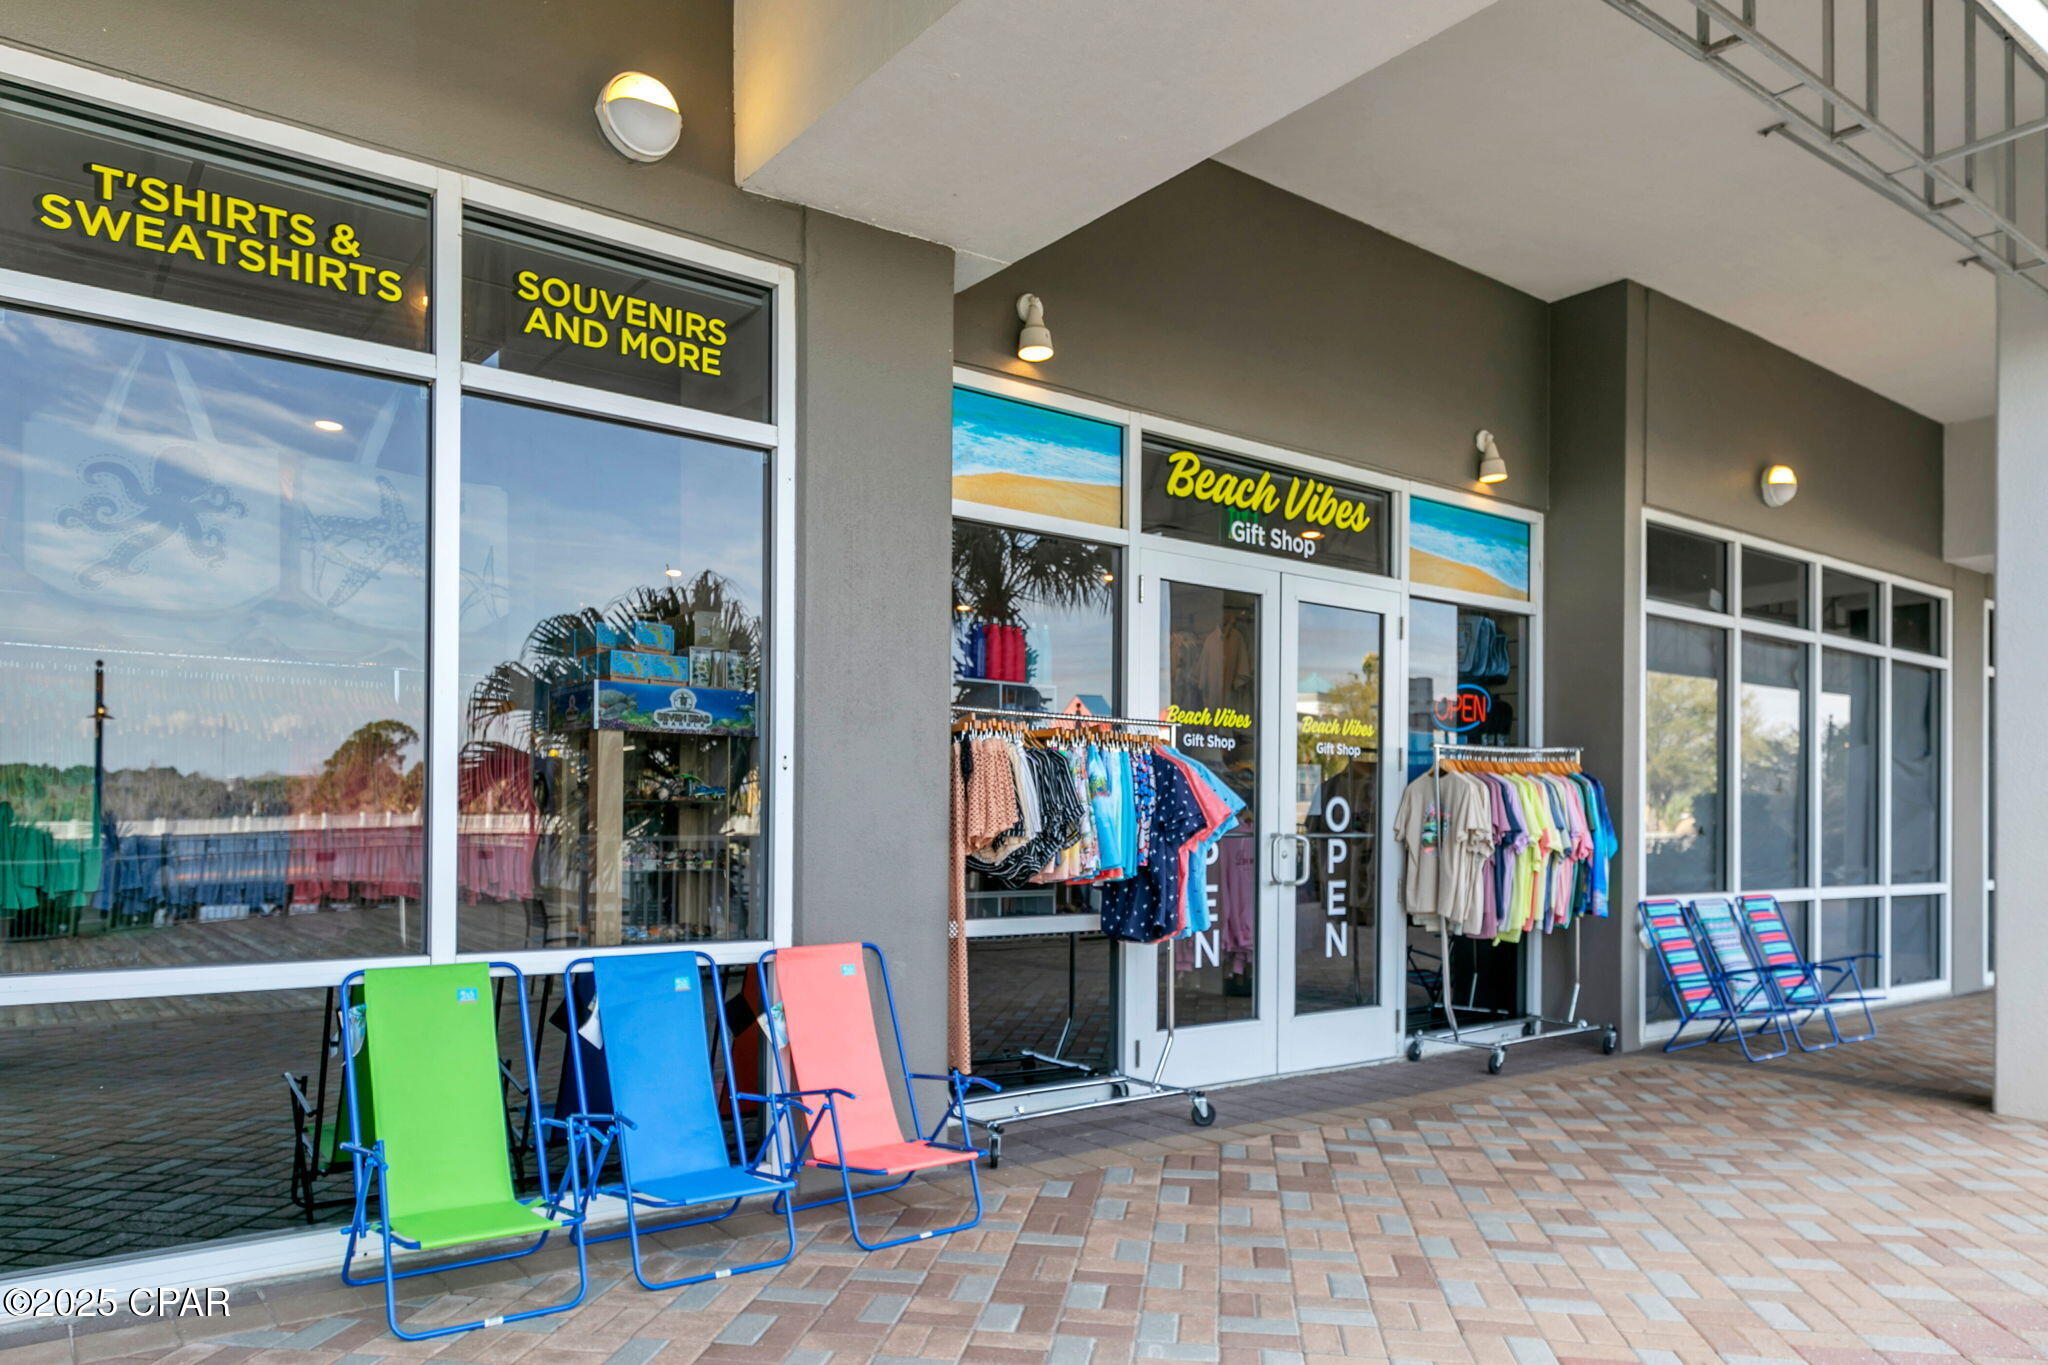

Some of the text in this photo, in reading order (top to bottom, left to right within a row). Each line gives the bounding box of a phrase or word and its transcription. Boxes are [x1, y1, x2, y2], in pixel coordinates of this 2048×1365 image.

[91, 163, 361, 258] T'SHIRTS &
[40, 193, 403, 302] SWEATSHIRTS
[517, 270, 728, 346] SOUVENIRS
[523, 307, 721, 376] AND MORE
[1166, 450, 1370, 532] Beach Vibes
[1230, 520, 1316, 558] Gift Shop
[1165, 704, 1252, 729] Beach Vibes
[1301, 715, 1375, 737] Beach Vibes
[1432, 693, 1487, 723] OPEN
[1182, 733, 1236, 752] Gift Shop
[1316, 741, 1362, 758] Gift Shop
[1325, 795, 1351, 958] OPEN
